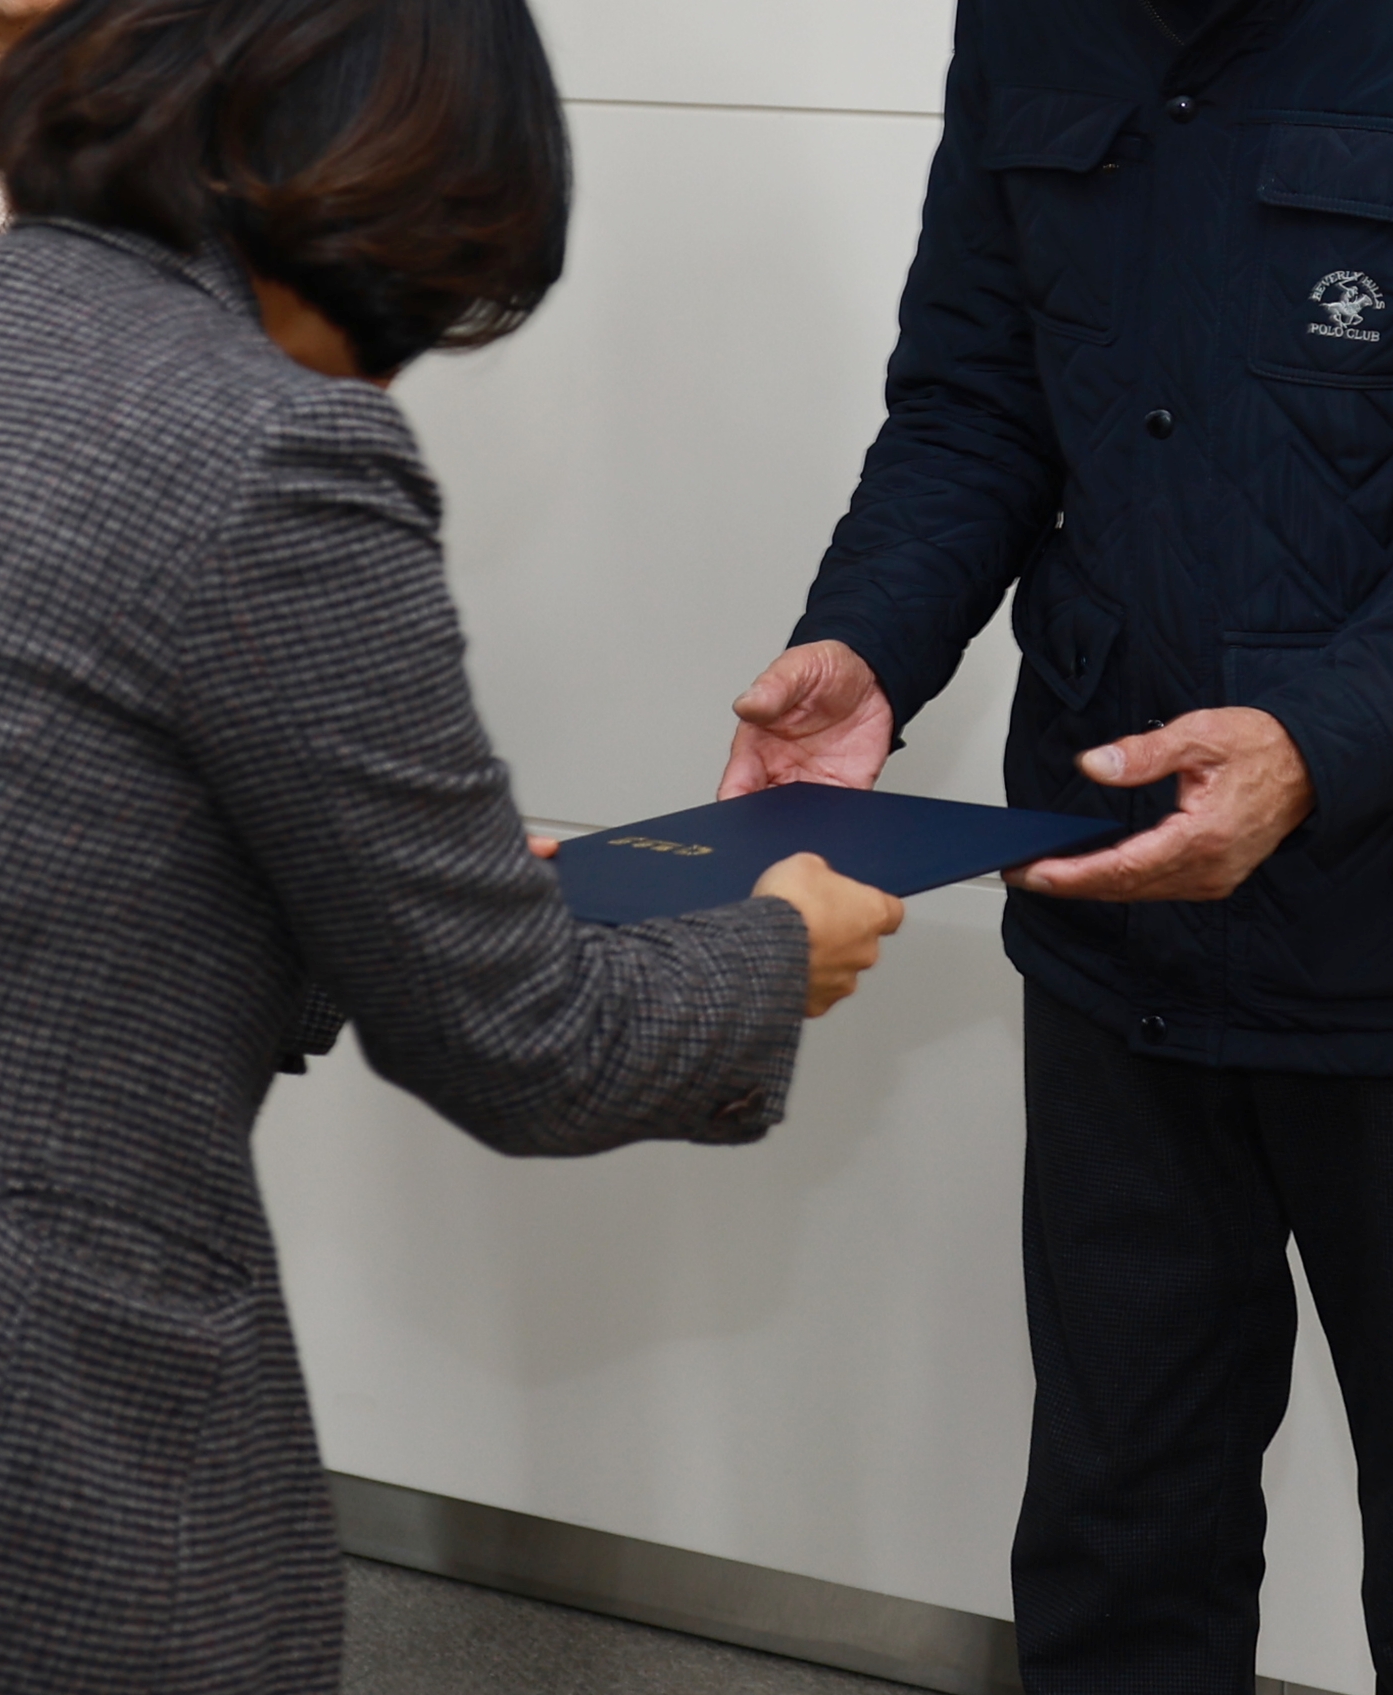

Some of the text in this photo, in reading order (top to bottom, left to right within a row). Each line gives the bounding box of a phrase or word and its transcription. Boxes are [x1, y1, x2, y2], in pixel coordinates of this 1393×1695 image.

[1309, 270, 1386, 310] BEVERLY HILLS
[1309, 322, 1381, 343] POLO CLUB
